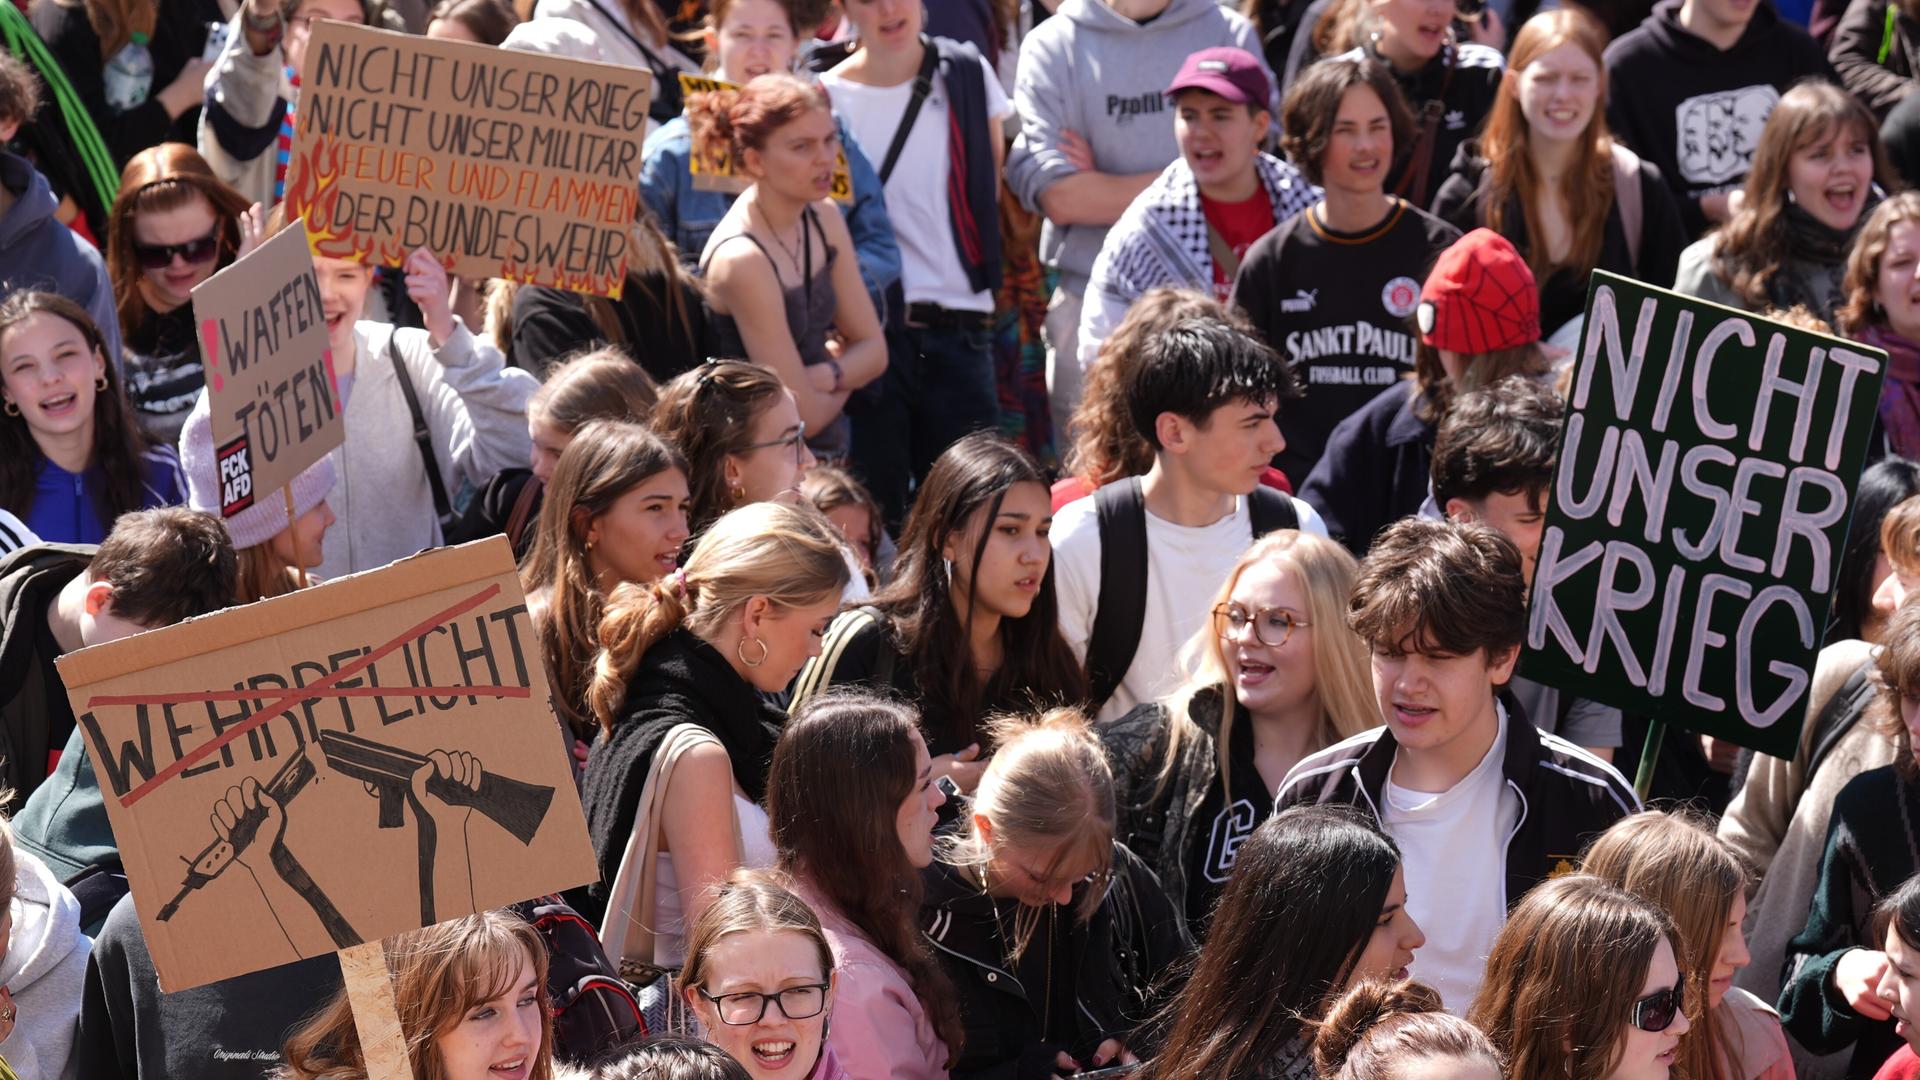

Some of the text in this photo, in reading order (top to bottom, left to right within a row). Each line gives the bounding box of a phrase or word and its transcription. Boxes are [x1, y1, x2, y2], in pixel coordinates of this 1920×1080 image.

[315, 42, 646, 132] NICHT UNSER KRIEG
[307, 93, 424, 147] NICHT
[427, 110, 521, 164] UNSER
[526, 125, 638, 181] MILITÄR
[341, 143, 637, 225] FEUER UND FLAMMEN
[333, 190, 627, 279] DER BUNDESWEHR
[1285, 324, 1356, 368] SANKT
[1363, 366, 1396, 385] CLUB
[1573, 284, 1880, 471] NICHT
[220, 447, 251, 484] FCK
[223, 475, 252, 507] AFD
[1556, 412, 1848, 595] UNSER
[1527, 526, 1815, 729] KRIEG
[79, 603, 531, 798] WEHRPFLICHT
[213, 1048, 251, 1062] Originals
